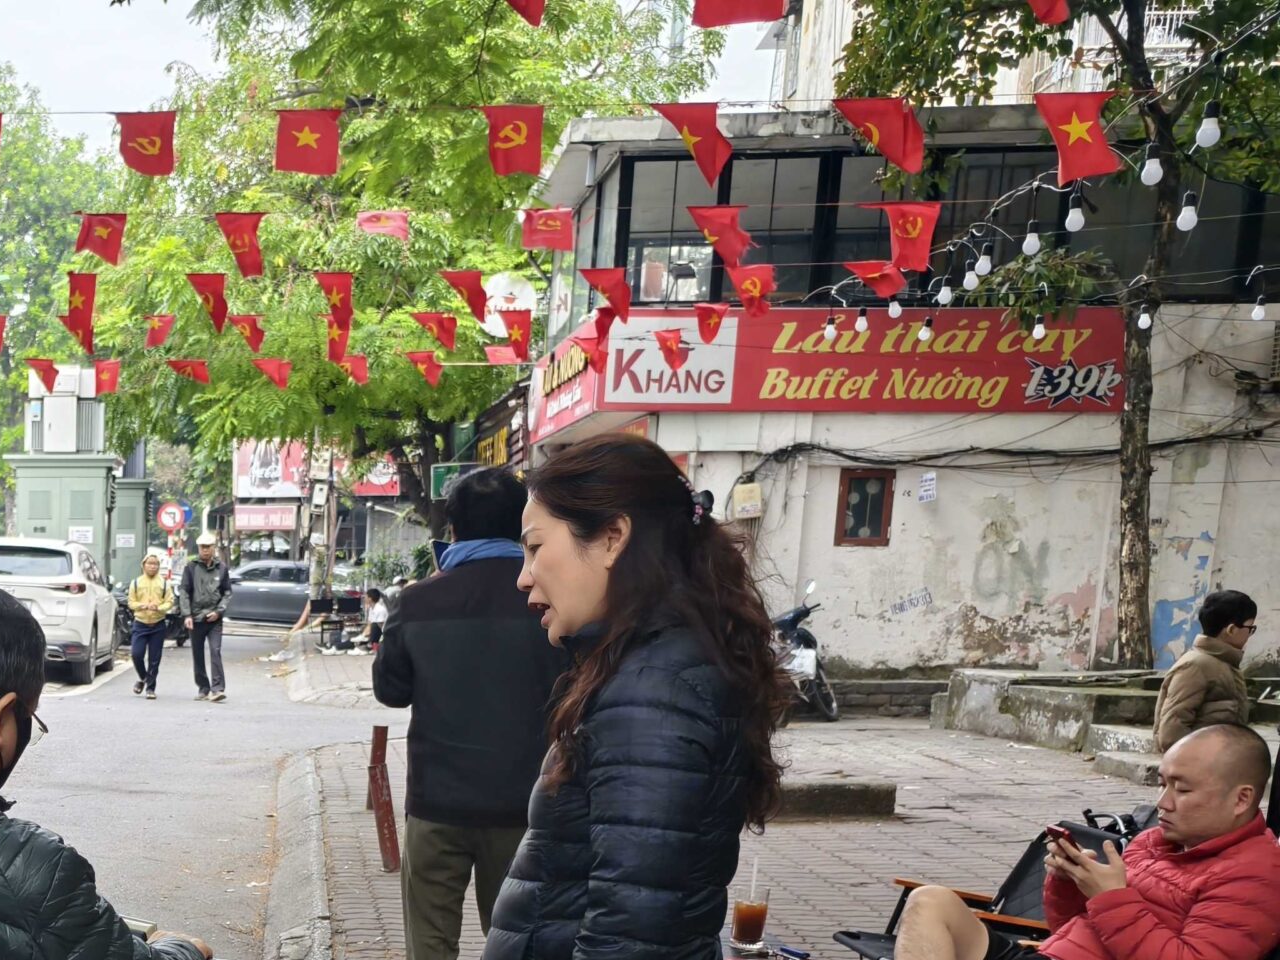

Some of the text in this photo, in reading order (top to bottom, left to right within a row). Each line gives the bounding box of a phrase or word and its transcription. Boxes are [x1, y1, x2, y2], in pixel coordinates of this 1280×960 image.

[880, 319, 991, 354] thái
[759, 364, 1122, 408] Buffet Nướng 139k
